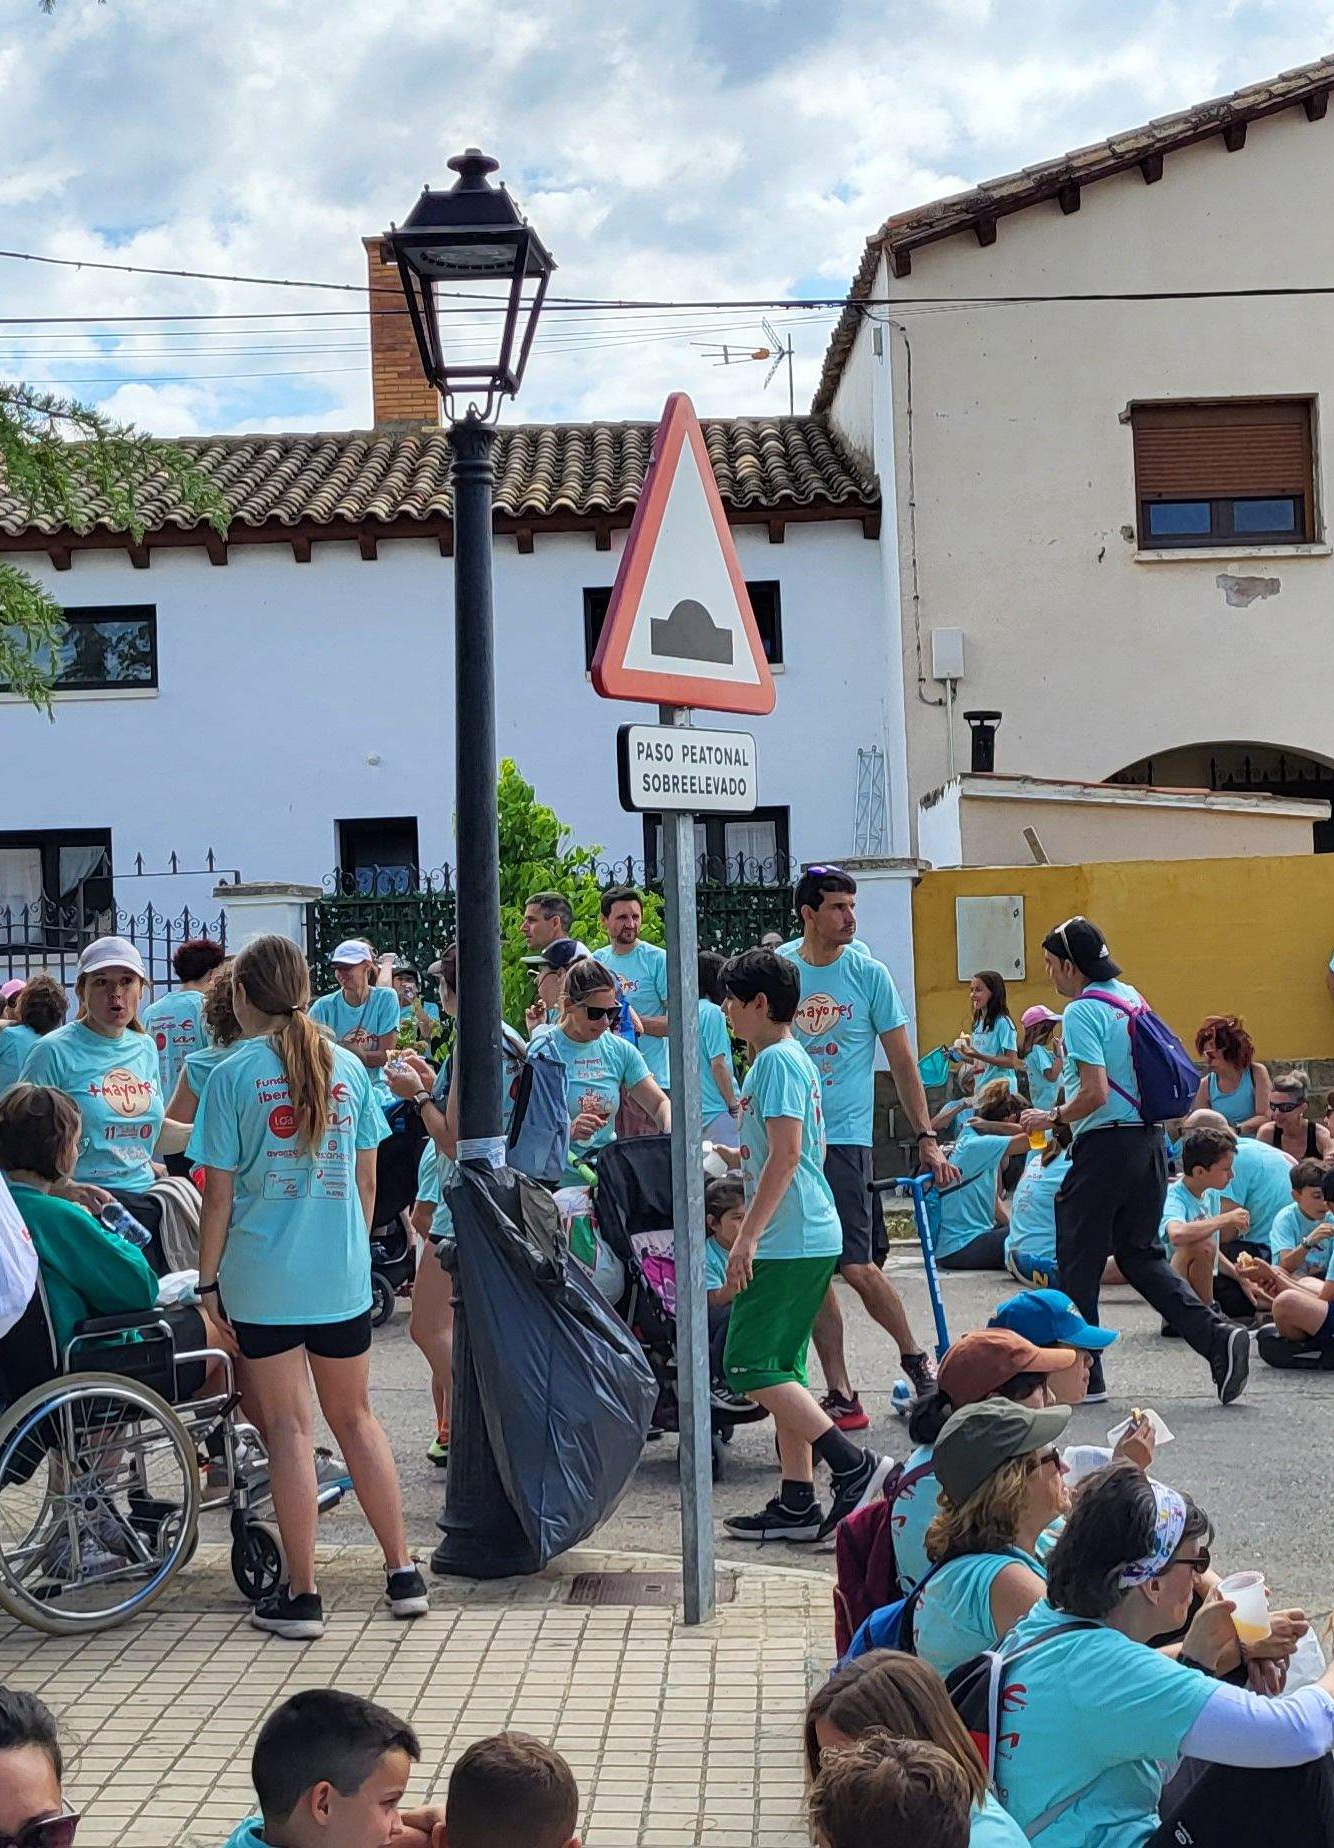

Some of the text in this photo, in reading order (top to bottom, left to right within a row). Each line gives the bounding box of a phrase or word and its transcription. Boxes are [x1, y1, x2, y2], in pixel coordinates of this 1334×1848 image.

[636, 741, 749, 767] PASO PEATONAL
[642, 773, 747, 796] SOBREELEVADO
